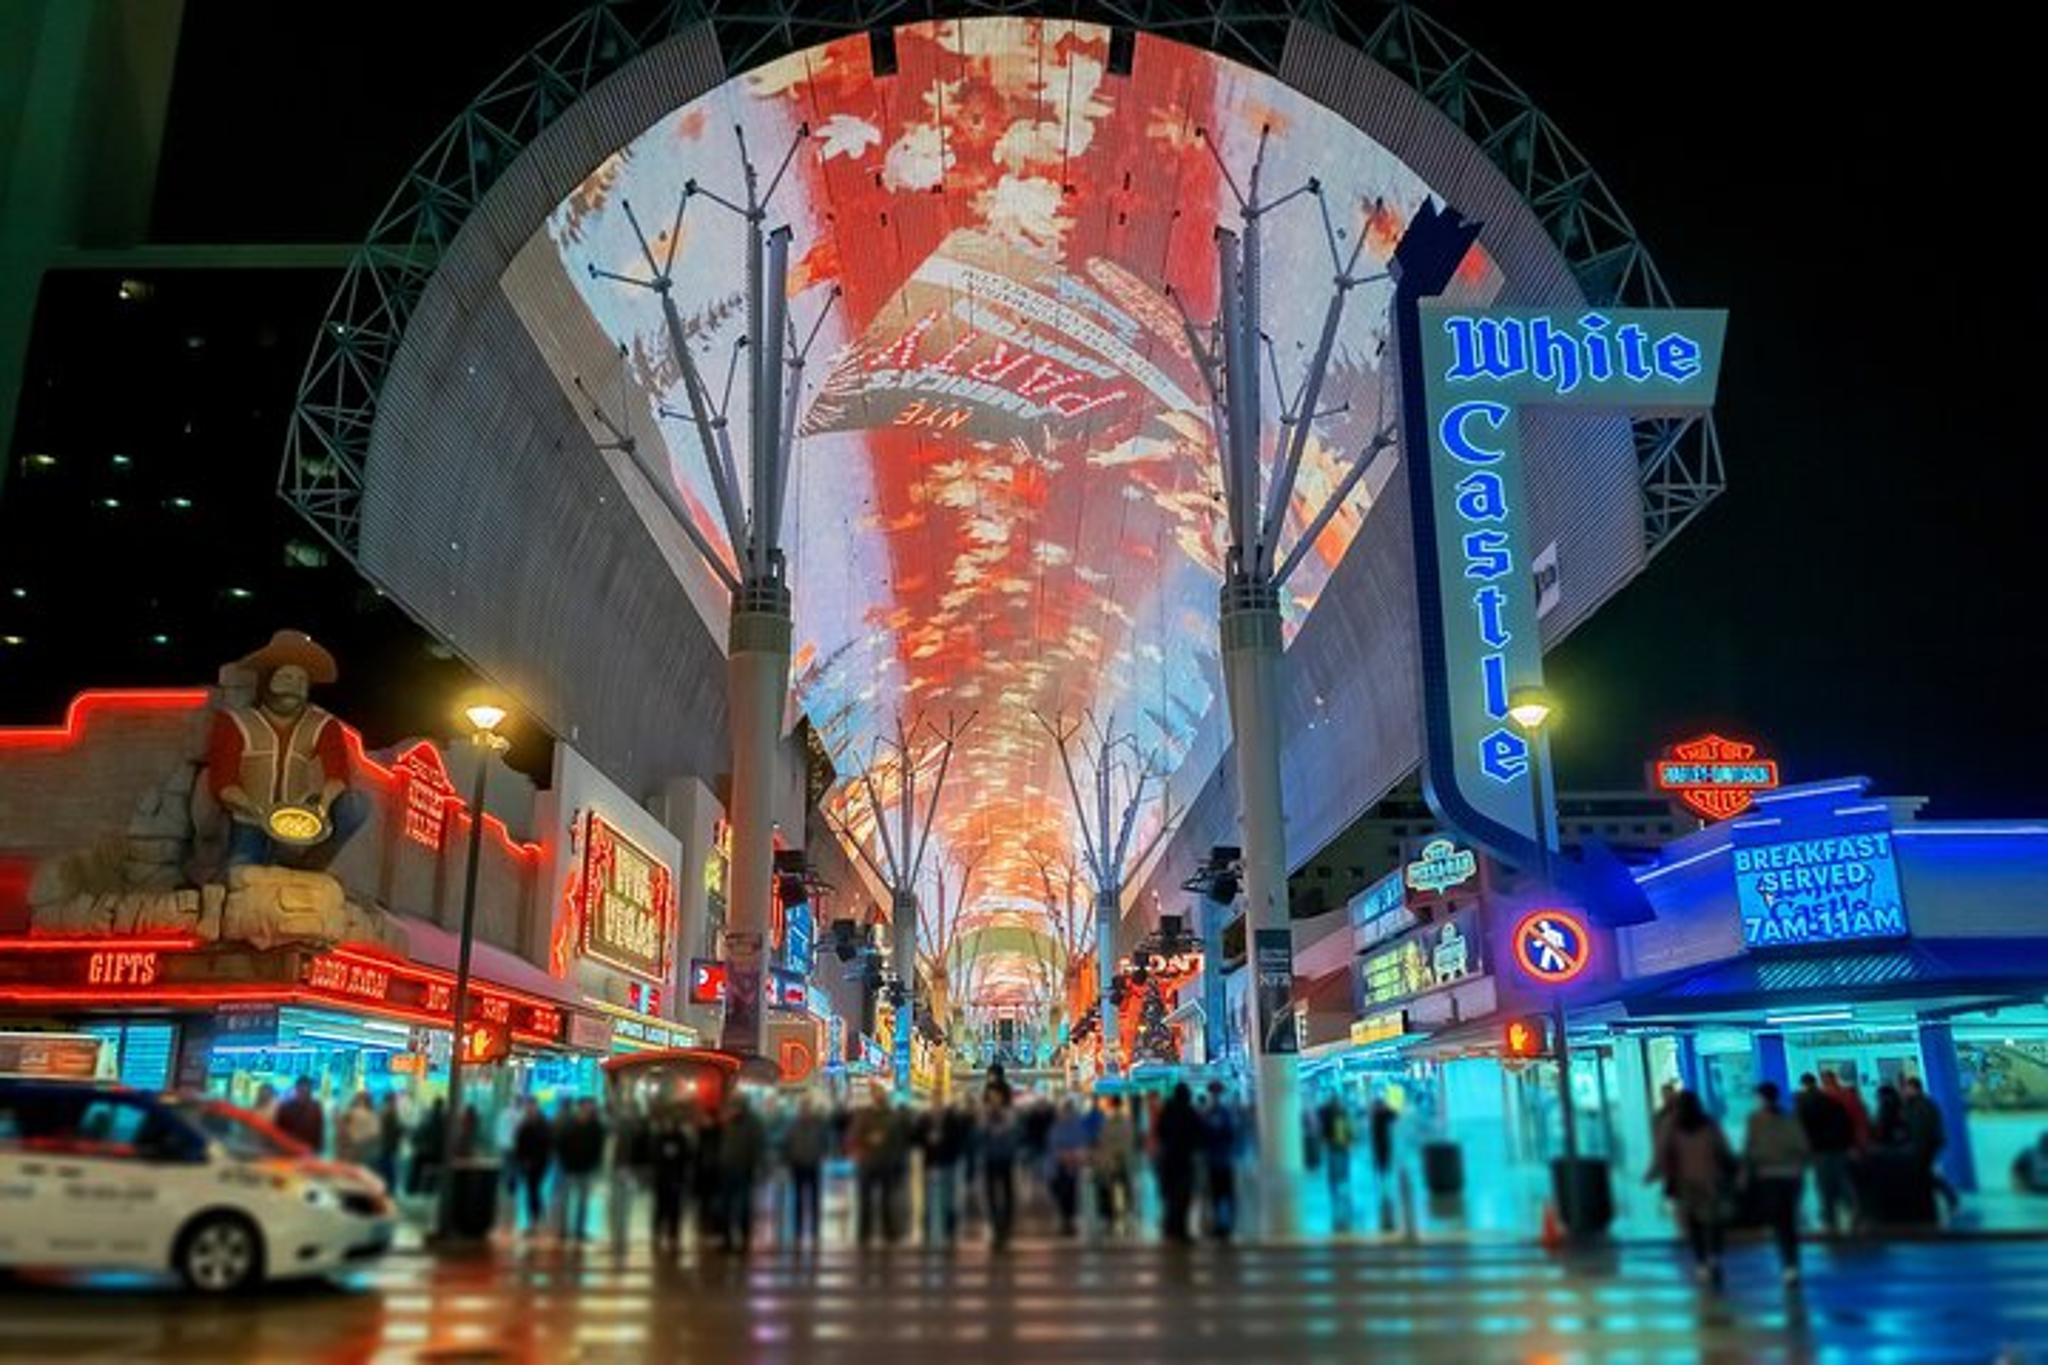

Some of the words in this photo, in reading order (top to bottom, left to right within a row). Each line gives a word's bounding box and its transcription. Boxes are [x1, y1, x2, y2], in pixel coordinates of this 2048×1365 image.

[867, 309, 1127, 418] PARTY
[1444, 313, 1702, 394] White
[894, 401, 973, 427] NYE
[1438, 401, 1532, 782] Castle
[1735, 832, 1891, 871] BREAKFAST
[1763, 862, 1867, 892] SERVED
[1745, 906, 1902, 943] 7AM-11AM
[87, 952, 158, 985] GIFTS
